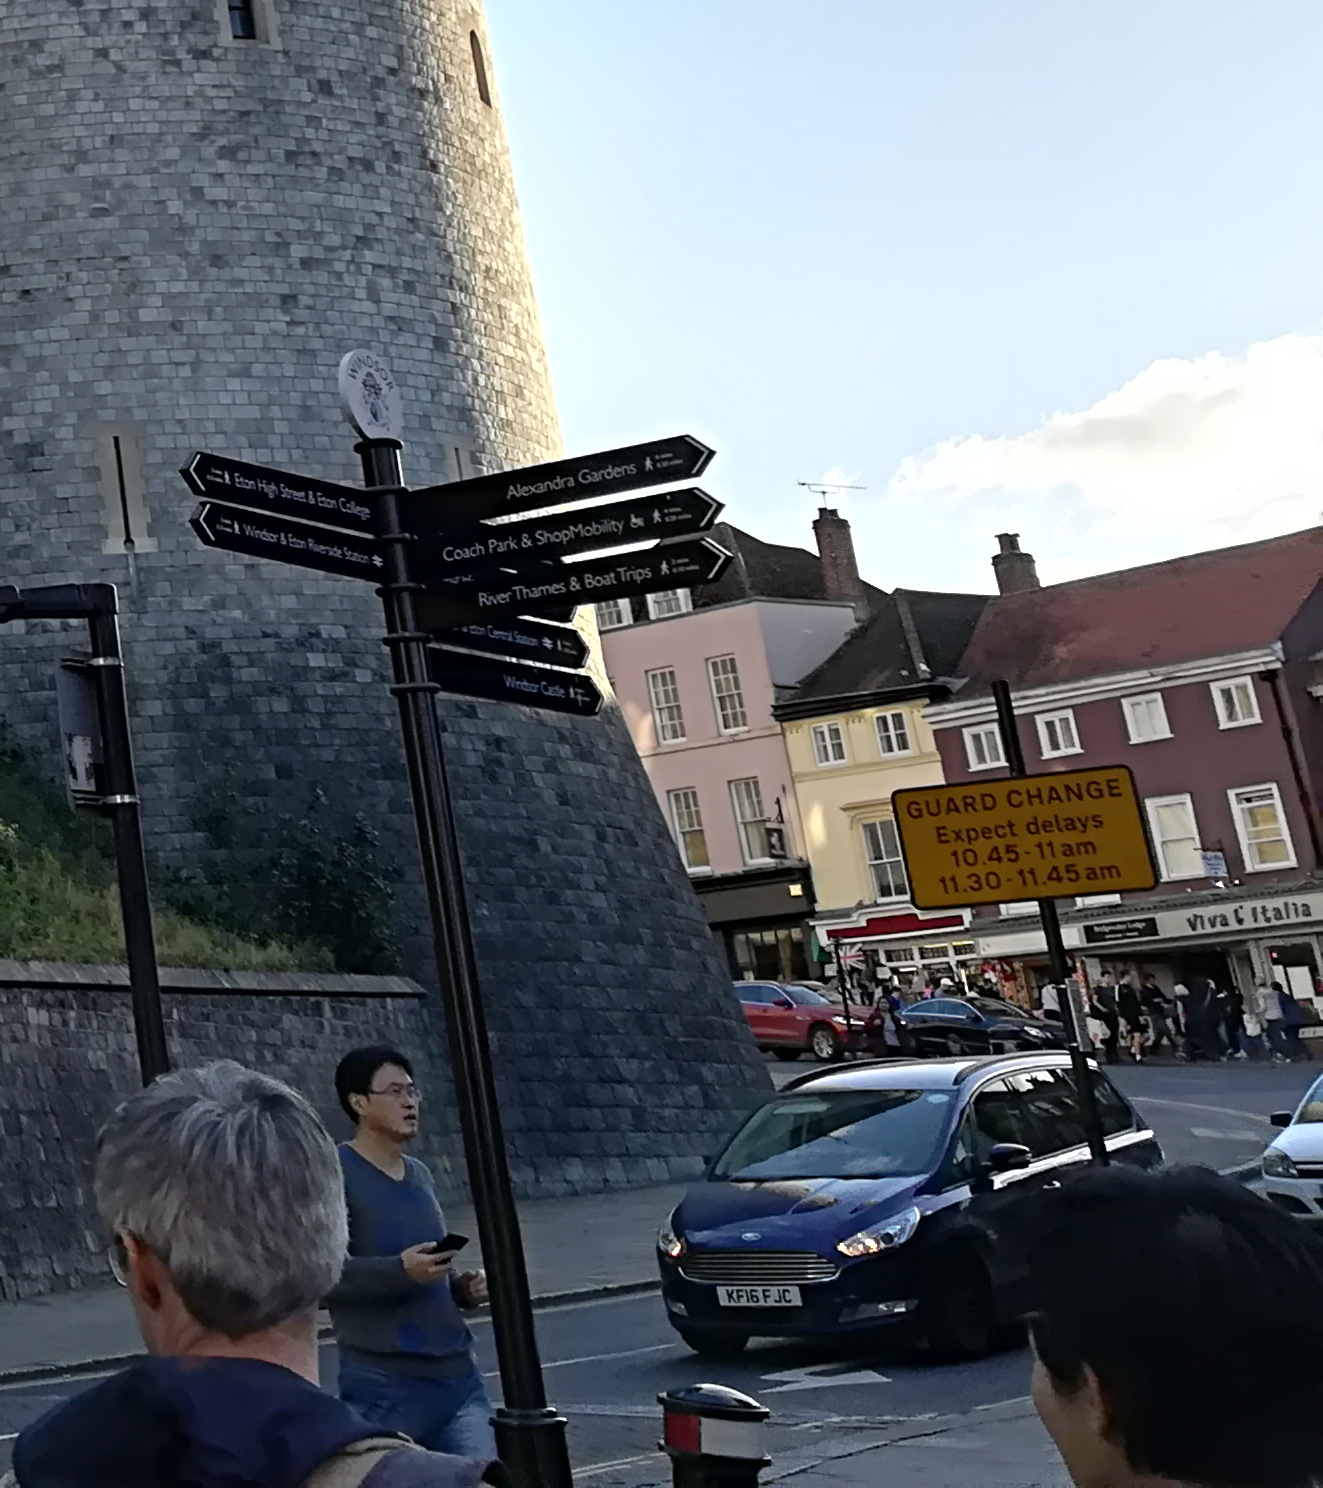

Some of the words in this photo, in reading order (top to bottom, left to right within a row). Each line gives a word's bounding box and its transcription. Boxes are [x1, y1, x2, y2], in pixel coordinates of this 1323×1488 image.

[348, 355, 394, 392] WINDSOR
[234, 472, 257, 490] Eton
[257, 478, 279, 499] High
[279, 483, 308, 503] Street
[308, 490, 316, 504] &
[316, 492, 338, 509] Eton
[339, 497, 371, 521] College
[506, 475, 575, 500] Alexandra
[578, 462, 638, 485] Gardens
[242, 523, 279, 543] Windsor
[280, 532, 288, 546] &
[287, 533, 307, 549] Eton
[307, 538, 343, 559] Riverside
[343, 547, 371, 565] Station
[442, 542, 486, 562] Coach
[488, 535, 519, 554] Park
[521, 533, 534, 548] &
[535, 517, 625, 548] ShopMobility
[479, 589, 513, 607] River
[512, 583, 566, 600] Thames
[569, 575, 582, 592] &
[584, 570, 617, 590] Boat
[616, 566, 653, 586] Trips
[487, 625, 513, 642] Central
[513, 630, 540, 647] Station
[503, 675, 540, 693] Windsor
[540, 681, 566, 698] Castle
[906, 793, 998, 820] GUARD
[1006, 778, 1124, 809] CHANGE
[935, 821, 1019, 845] Expect
[1025, 814, 1105, 837] delays
[1185, 913, 1230, 932] Viva
[725, 1288, 760, 1304] KF16
[761, 1288, 793, 1304] FJC
